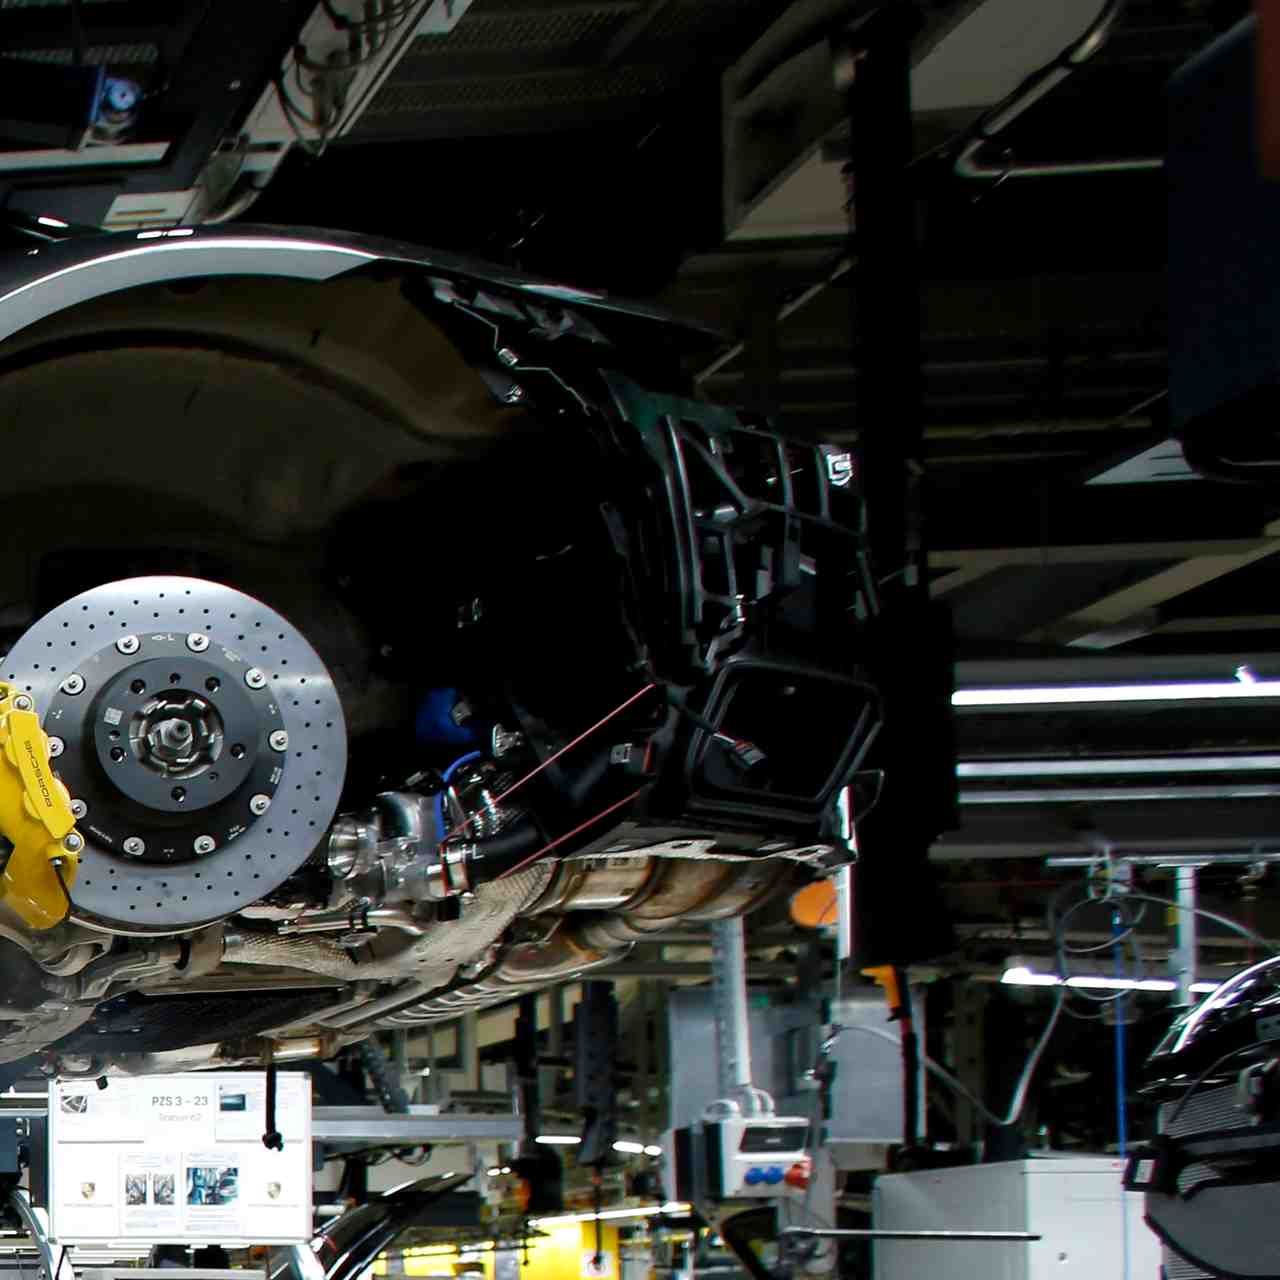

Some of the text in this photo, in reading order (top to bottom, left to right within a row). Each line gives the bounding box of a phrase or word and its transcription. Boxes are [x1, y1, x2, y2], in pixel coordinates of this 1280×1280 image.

[151, 1095, 174, 1107] PZS
[175, 1095, 183, 1106] 3
[193, 1095, 209, 1106] 23
